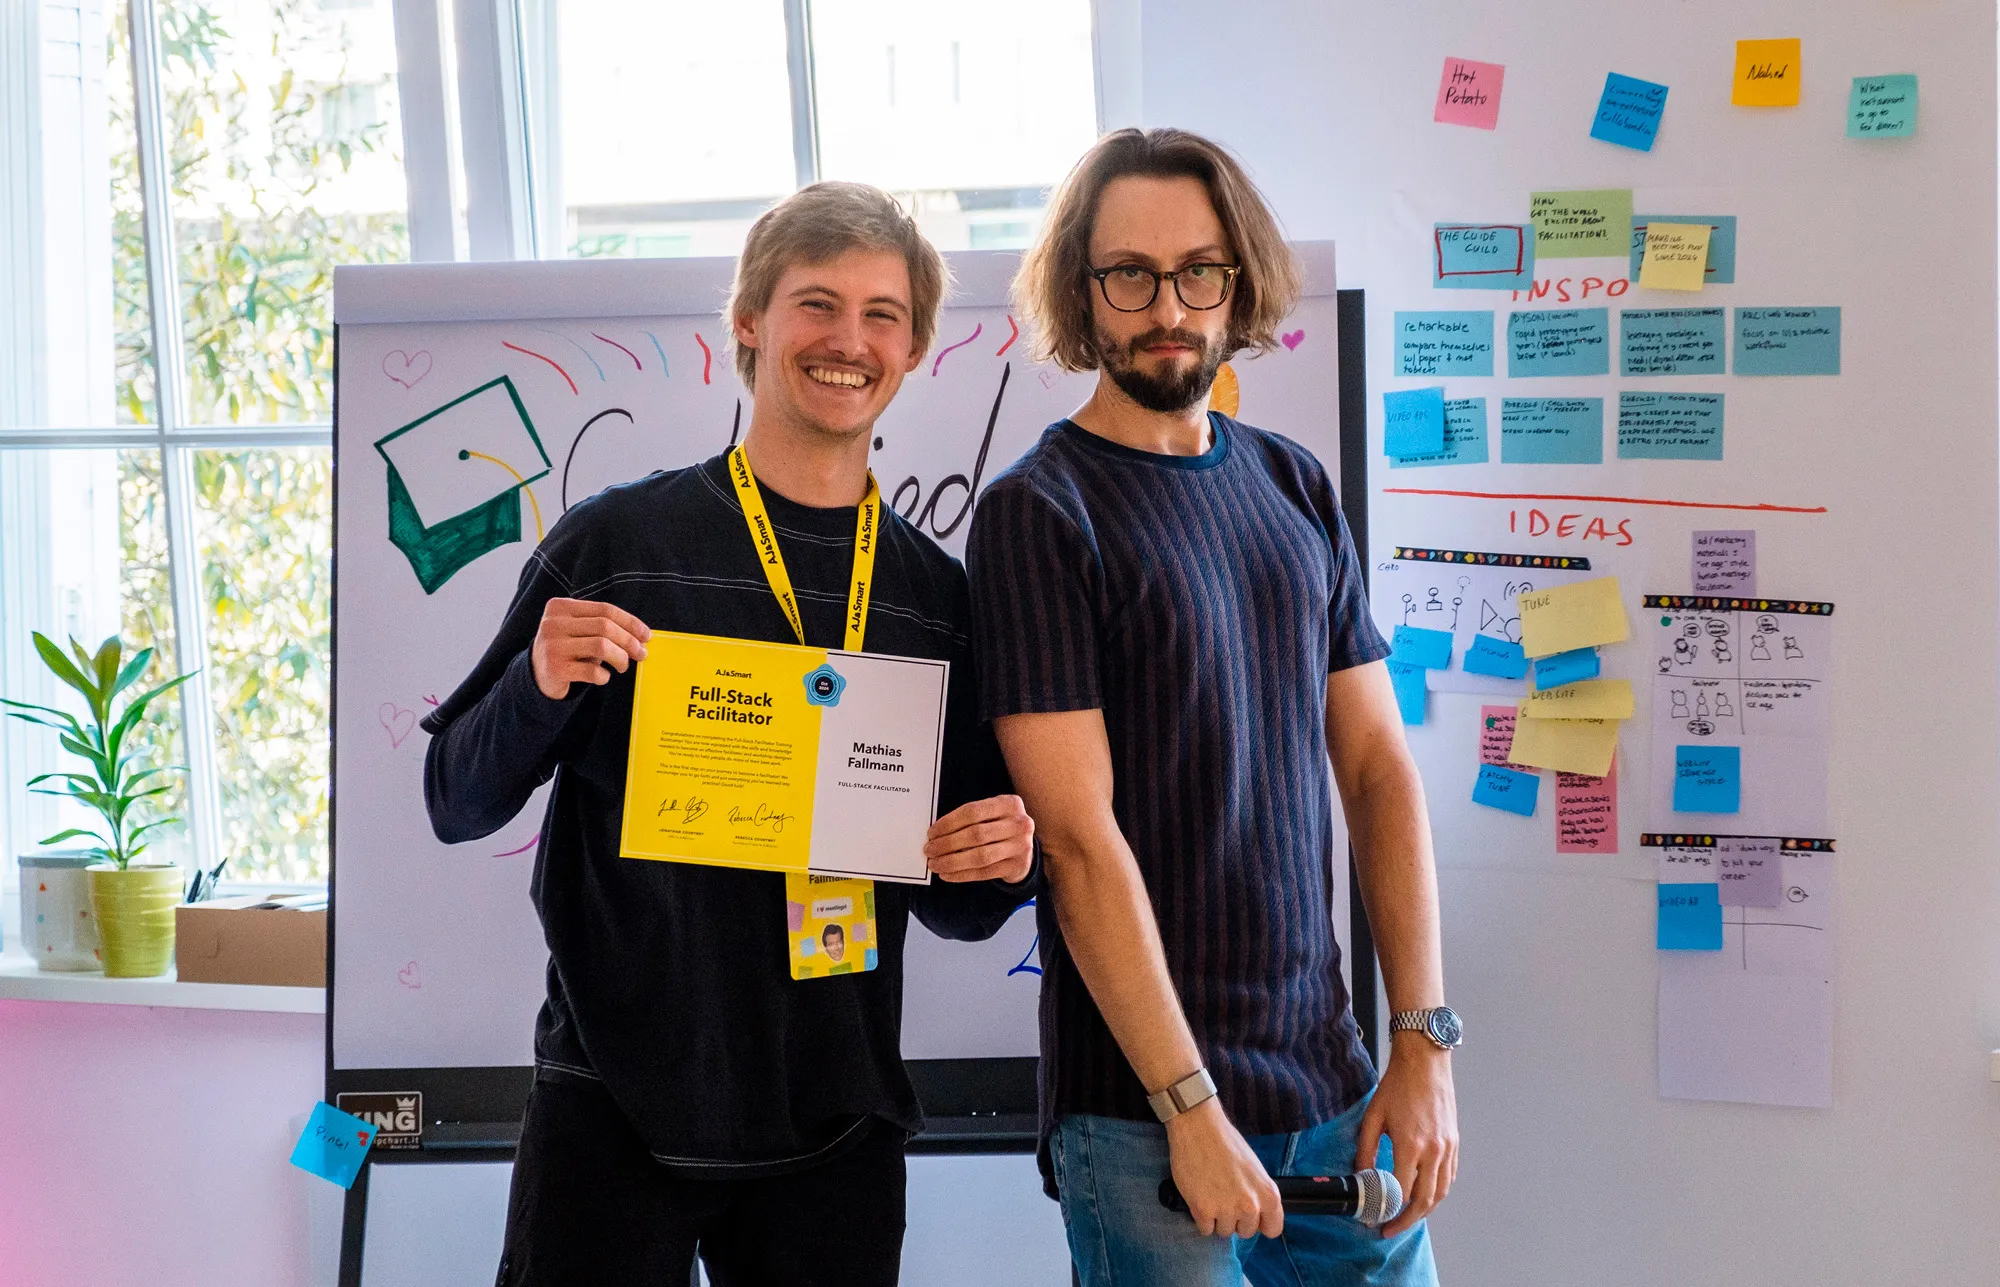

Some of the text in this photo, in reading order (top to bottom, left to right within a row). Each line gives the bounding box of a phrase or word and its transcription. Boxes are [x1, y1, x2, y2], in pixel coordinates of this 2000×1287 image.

[1452, 64, 1476, 84] Hot
[1445, 87, 1487, 106] Potato
[1530, 208, 1547, 218] GET
[1551, 208, 1569, 216] THE
[1437, 231, 1497, 241] THE GUIDE
[1464, 244, 1499, 254] GUILD
[1403, 340, 1491, 354] compare themselves
[860, 503, 874, 555] AJ&Smart
[1510, 509, 1633, 546] IDEAS
[753, 514, 778, 565] AJ&Smart
[851, 580, 866, 632] AJ&Smart
[1522, 595, 1550, 611] TUNE
[715, 669, 752, 679] AJ&Smart
[690, 686, 773, 707] Full-Stack
[687, 704, 773, 725] Facilitator
[853, 742, 902, 757] Mathias
[847, 757, 904, 773] Fallmann
[873, 785, 910, 793] FACILITATOR
[1487, 781, 1511, 793] TUNE
[352, 1112, 416, 1131] ING
